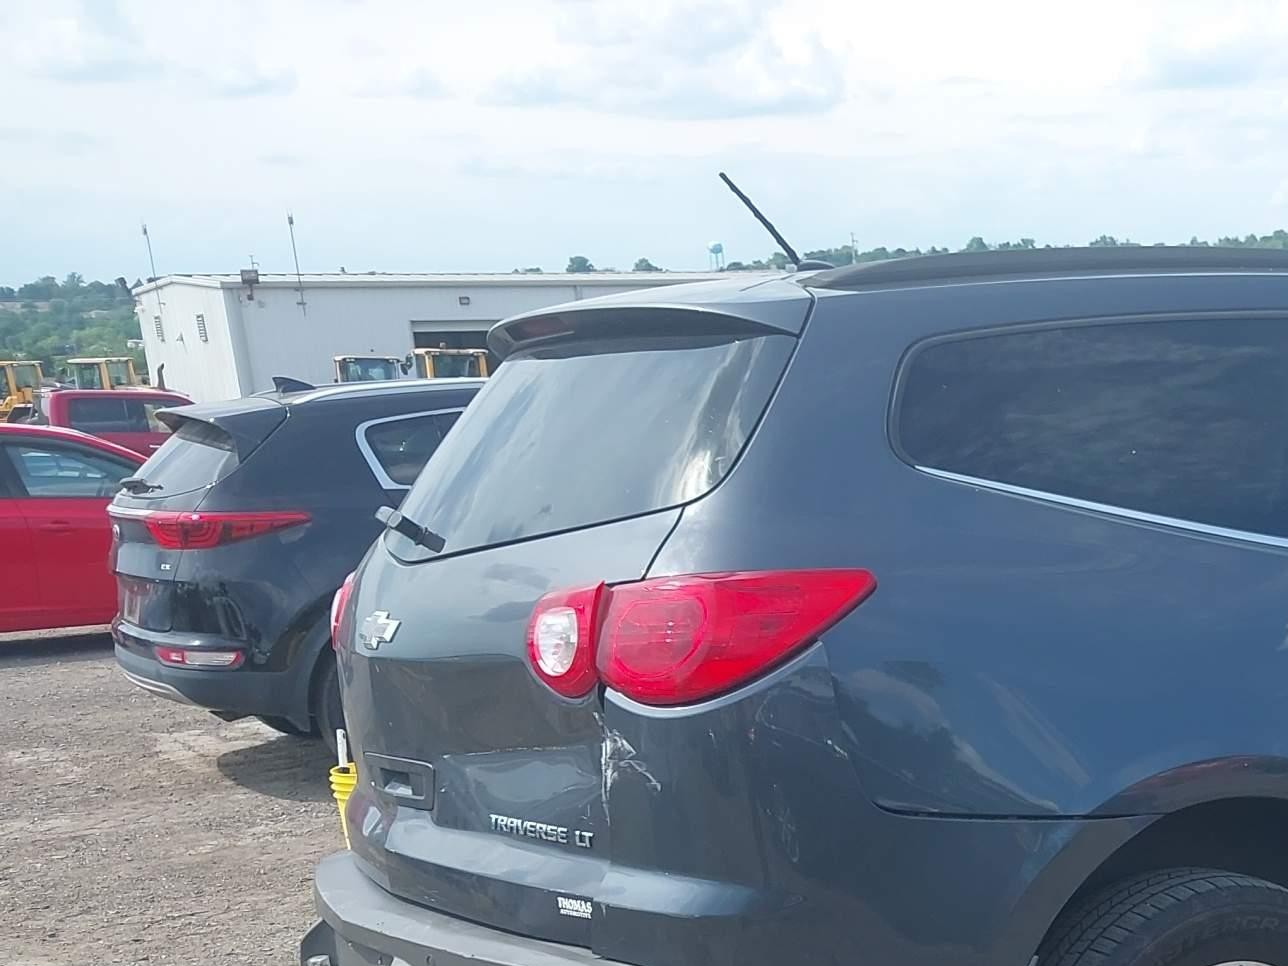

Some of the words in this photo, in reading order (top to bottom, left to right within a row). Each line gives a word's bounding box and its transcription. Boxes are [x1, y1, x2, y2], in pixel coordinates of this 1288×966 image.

[488, 813, 569, 844] TRAVERSE
[574, 829, 595, 849] LT
[556, 896, 593, 914] THOMAS
